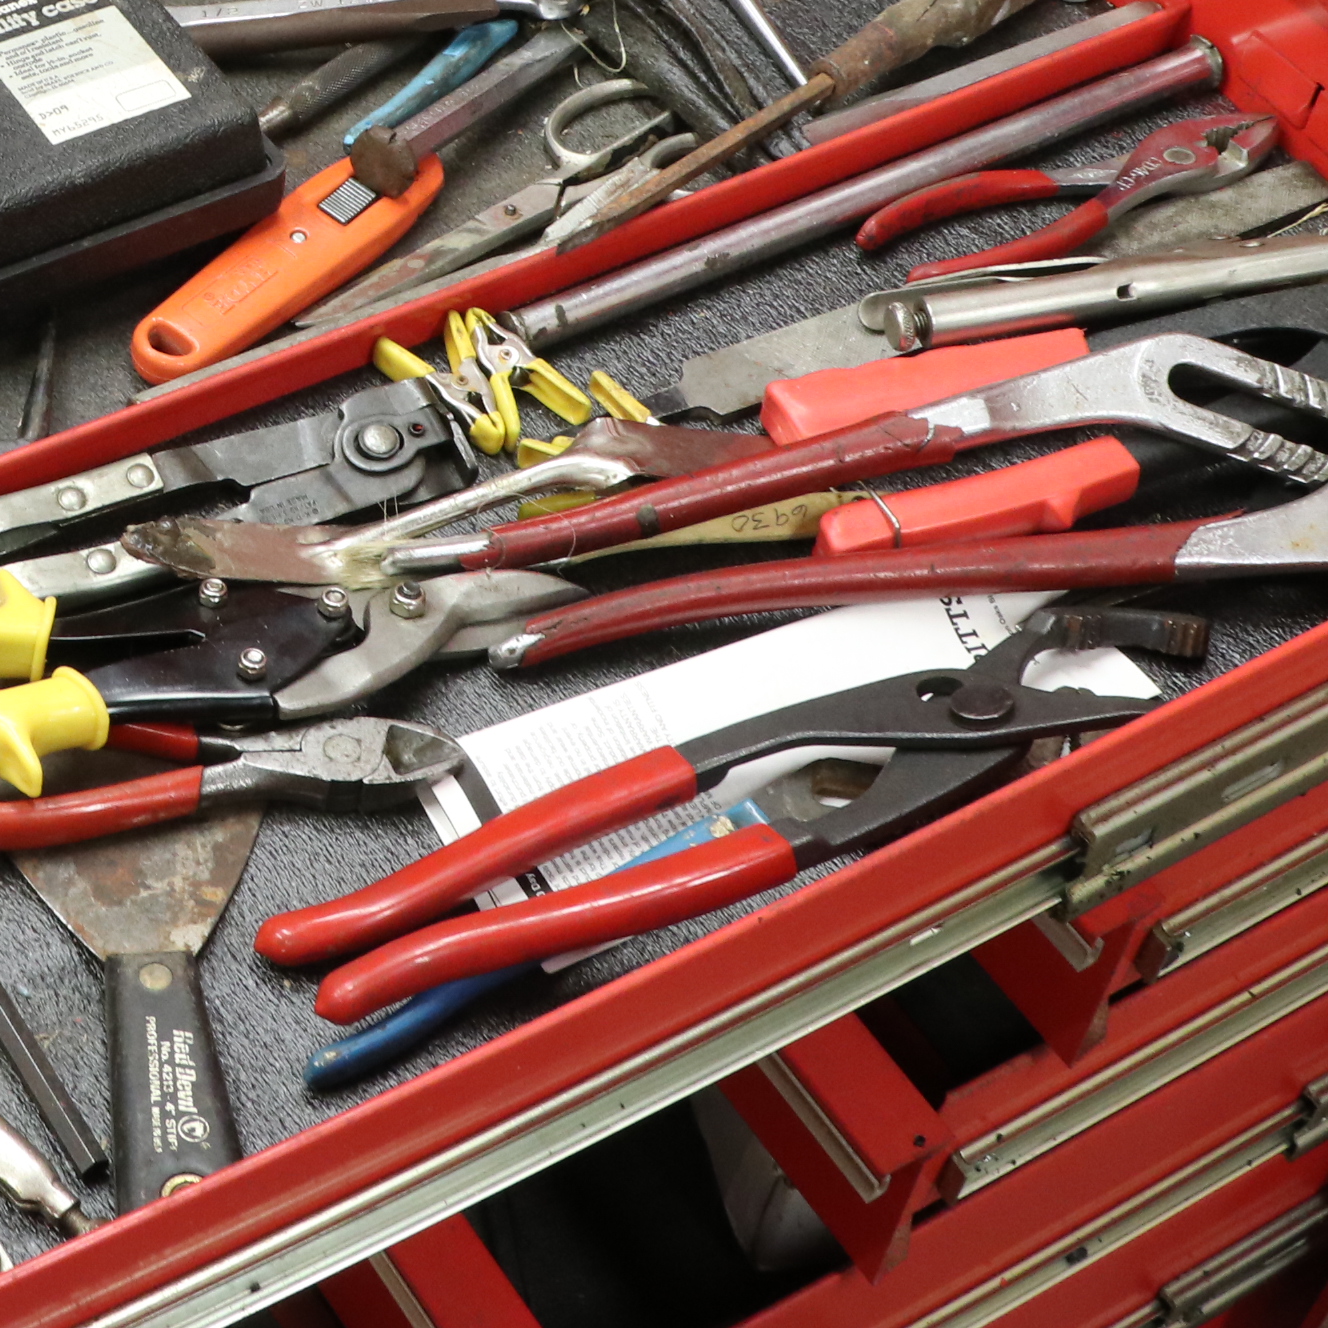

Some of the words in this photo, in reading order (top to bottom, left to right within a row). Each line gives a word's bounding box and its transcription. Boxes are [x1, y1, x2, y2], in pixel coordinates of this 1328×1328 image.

[201, 6, 239, 19] 1/2
[144, 1019, 162, 1099] PROFESSIONAL
[160, 1041, 171, 1061] No.
[173, 1030, 194, 1066] Red
[161, 1064, 173, 1091] 4213
[175, 1067, 198, 1112] Devil
